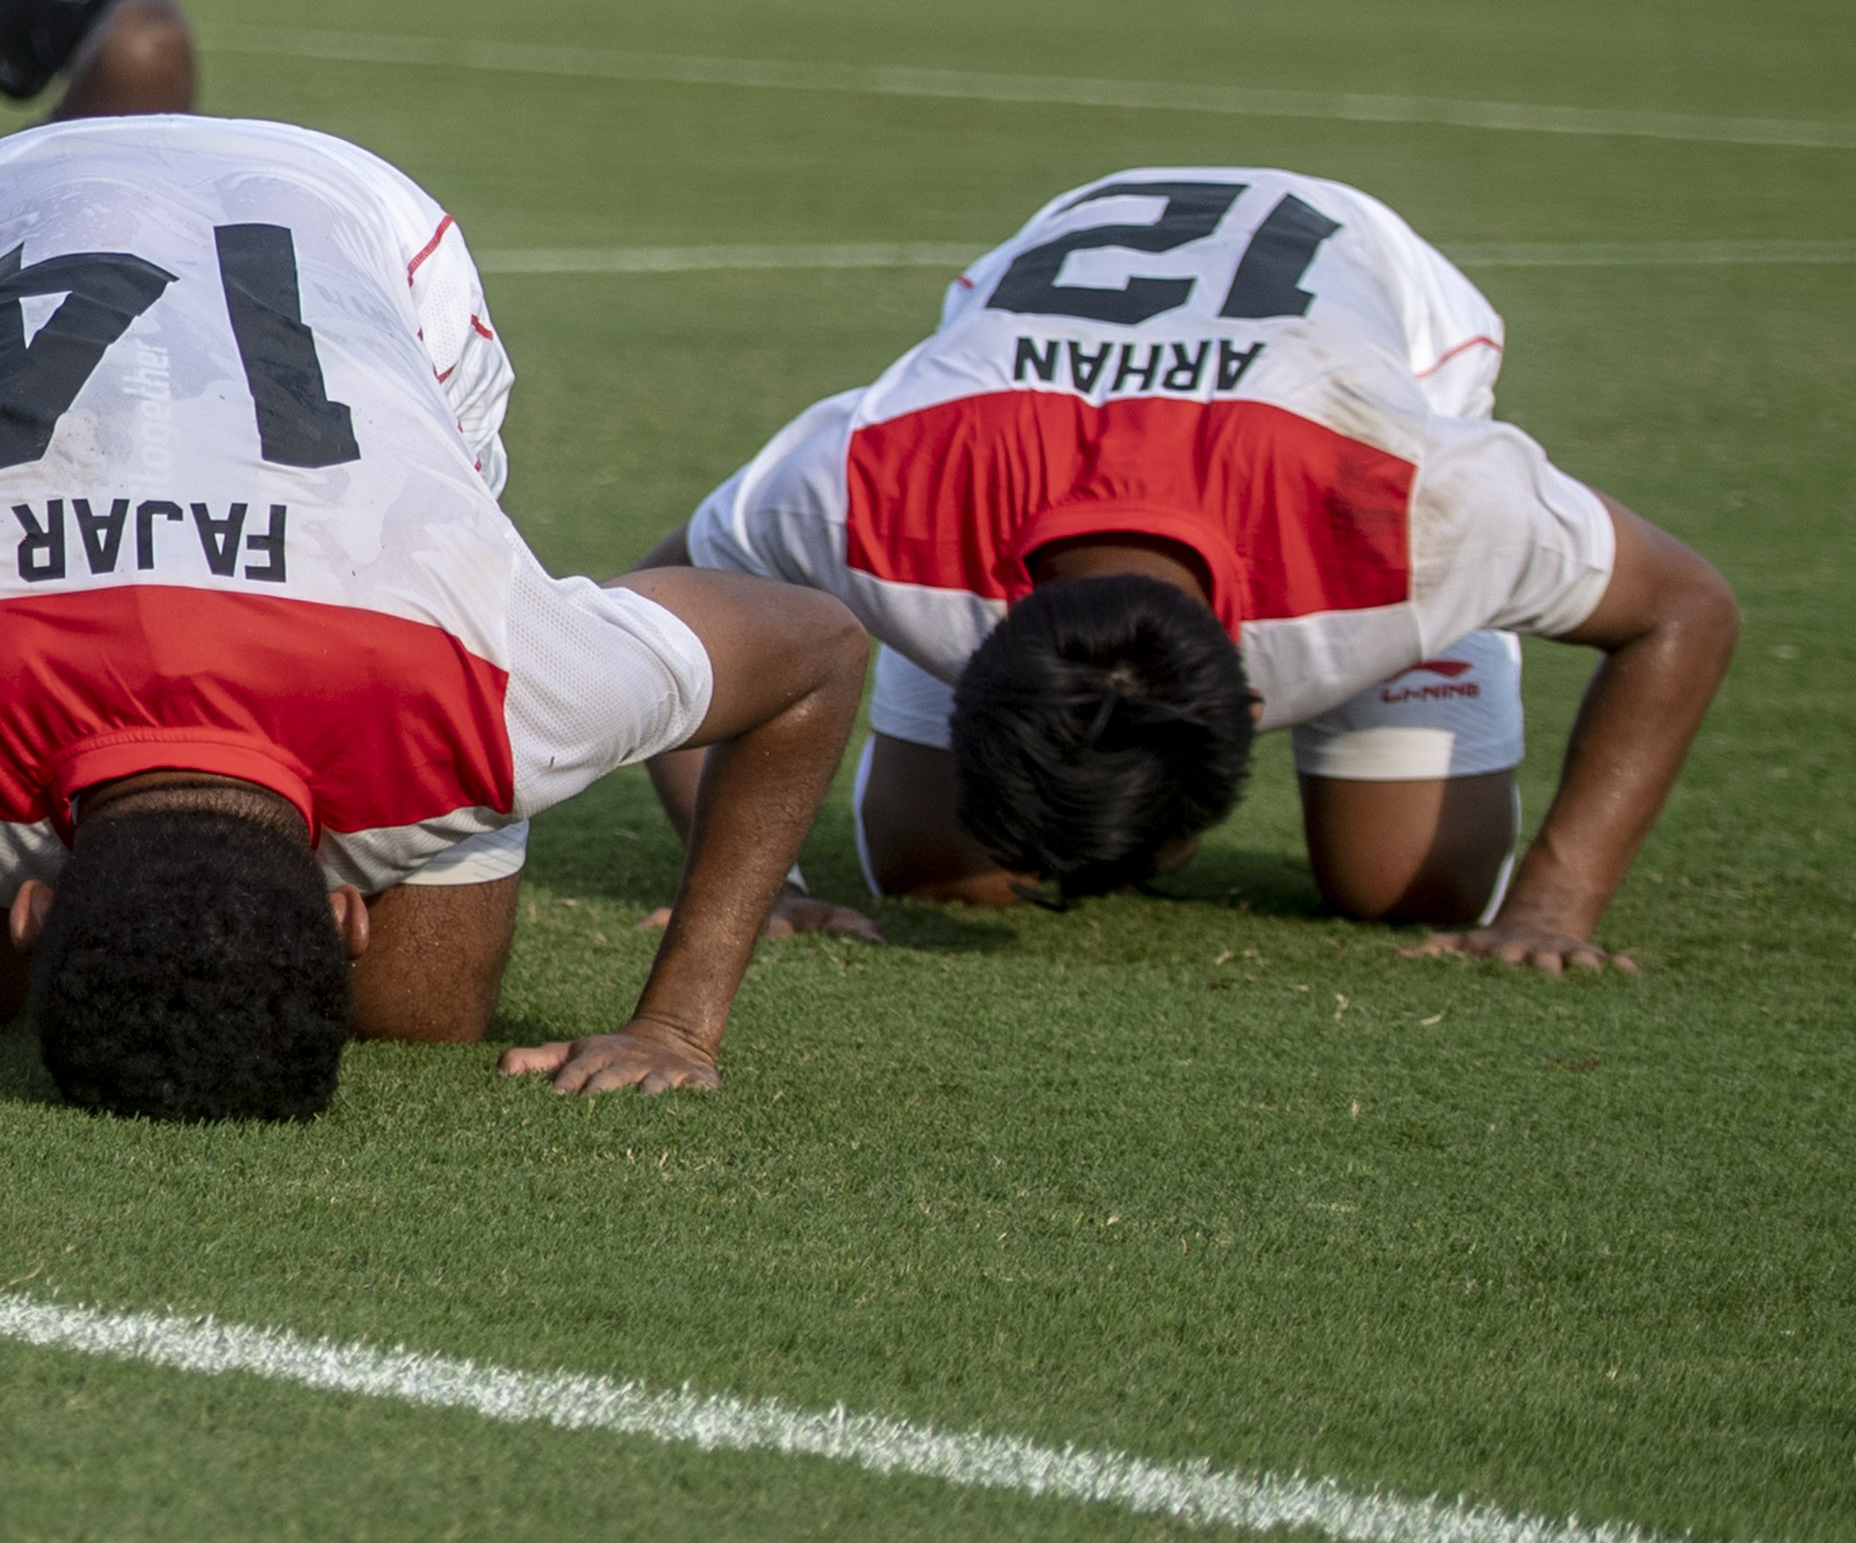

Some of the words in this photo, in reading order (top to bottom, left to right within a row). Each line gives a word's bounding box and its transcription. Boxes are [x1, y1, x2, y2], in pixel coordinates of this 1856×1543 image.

[986, 181, 1344, 326] 12
[1013, 336, 1267, 394] ARHAN
[10, 498, 288, 584] FAJAR
